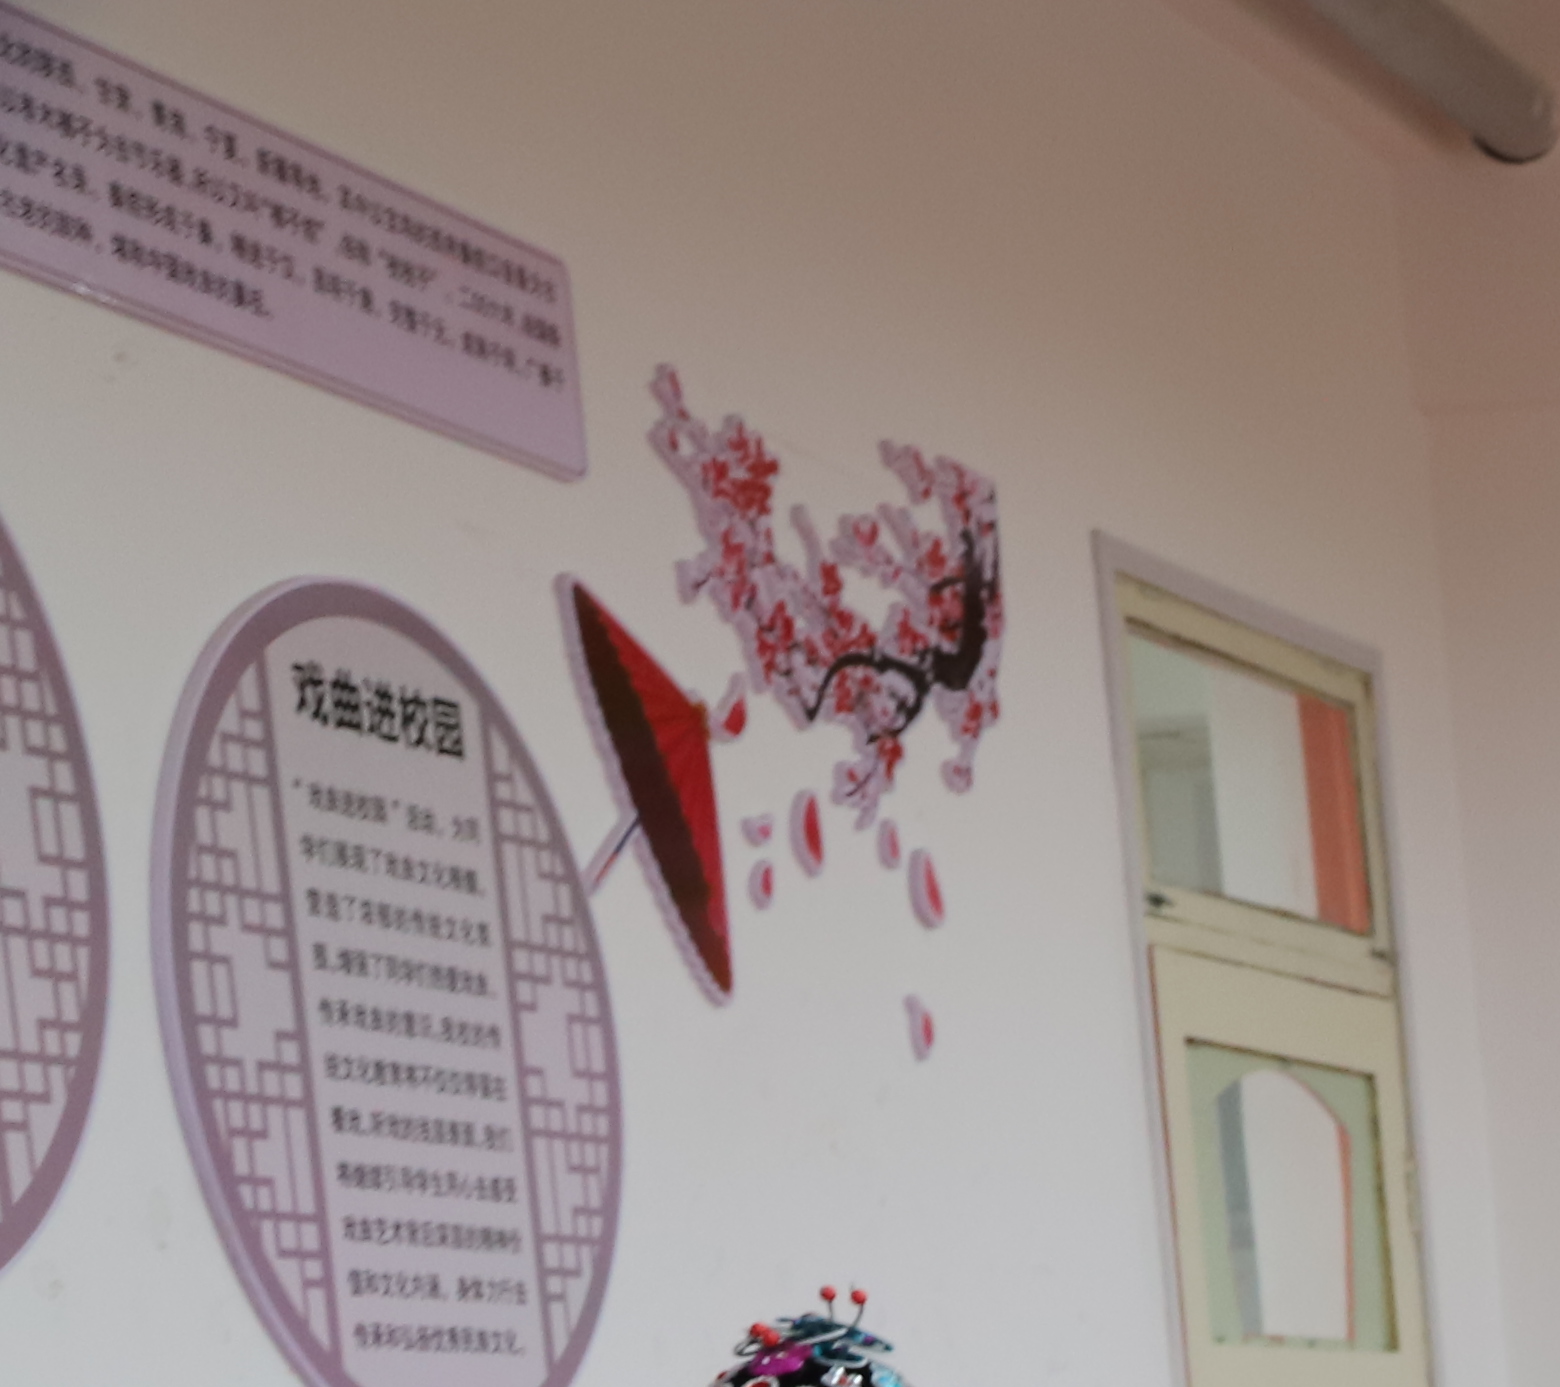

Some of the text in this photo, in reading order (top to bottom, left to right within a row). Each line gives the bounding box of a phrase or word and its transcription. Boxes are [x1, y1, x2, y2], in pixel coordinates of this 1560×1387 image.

[291, 660, 466, 761] 戏曲进校园
